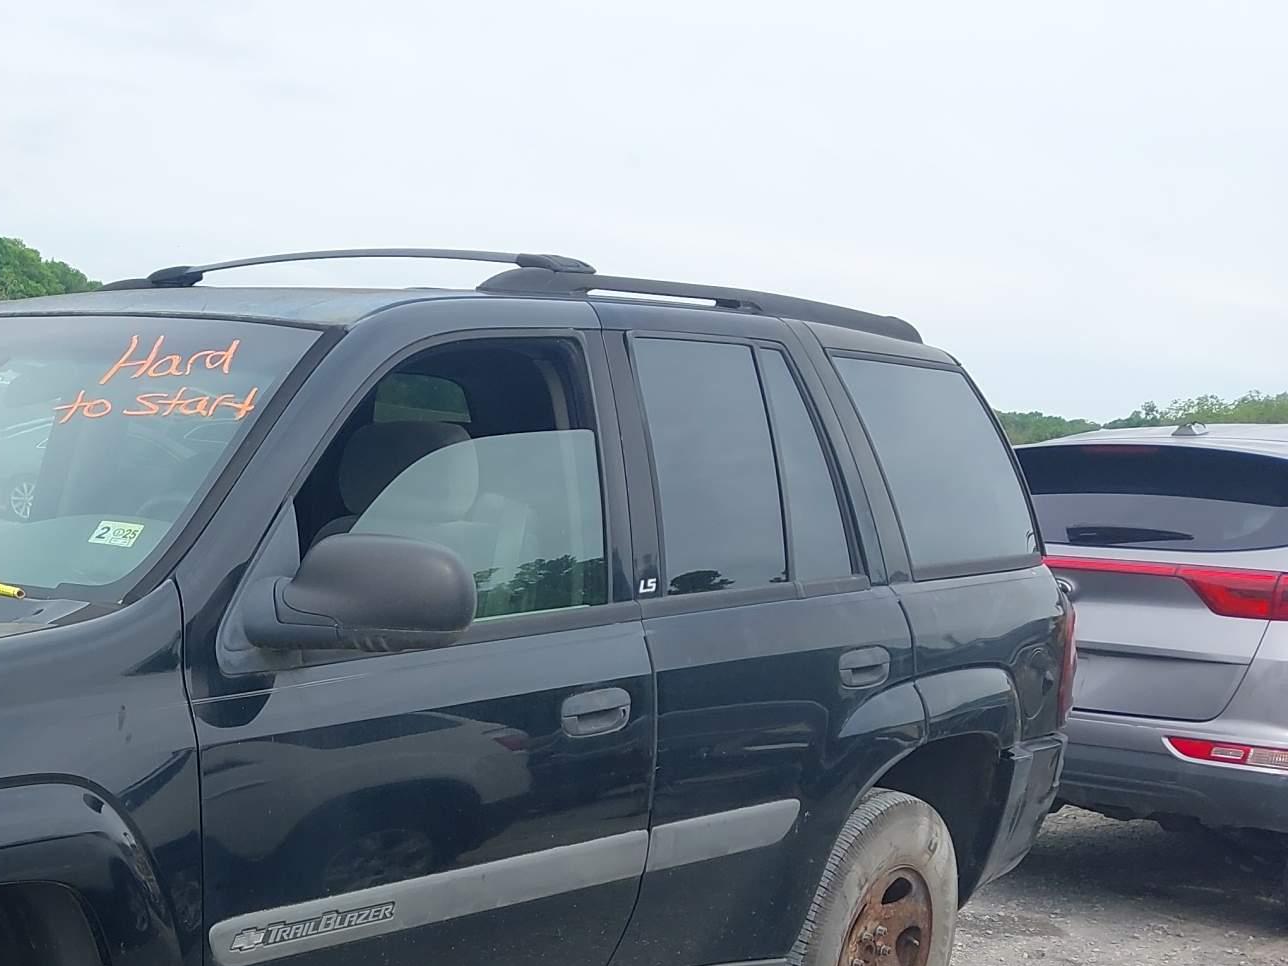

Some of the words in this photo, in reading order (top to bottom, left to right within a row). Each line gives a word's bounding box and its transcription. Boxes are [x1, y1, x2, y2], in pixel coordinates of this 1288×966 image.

[99, 335, 240, 385] Hard
[53, 390, 112, 424] to
[95, 526, 111, 540] 2
[122, 529, 139, 540] 25
[638, 577, 657, 594] LS
[266, 903, 394, 944] TRAILBLAZER
